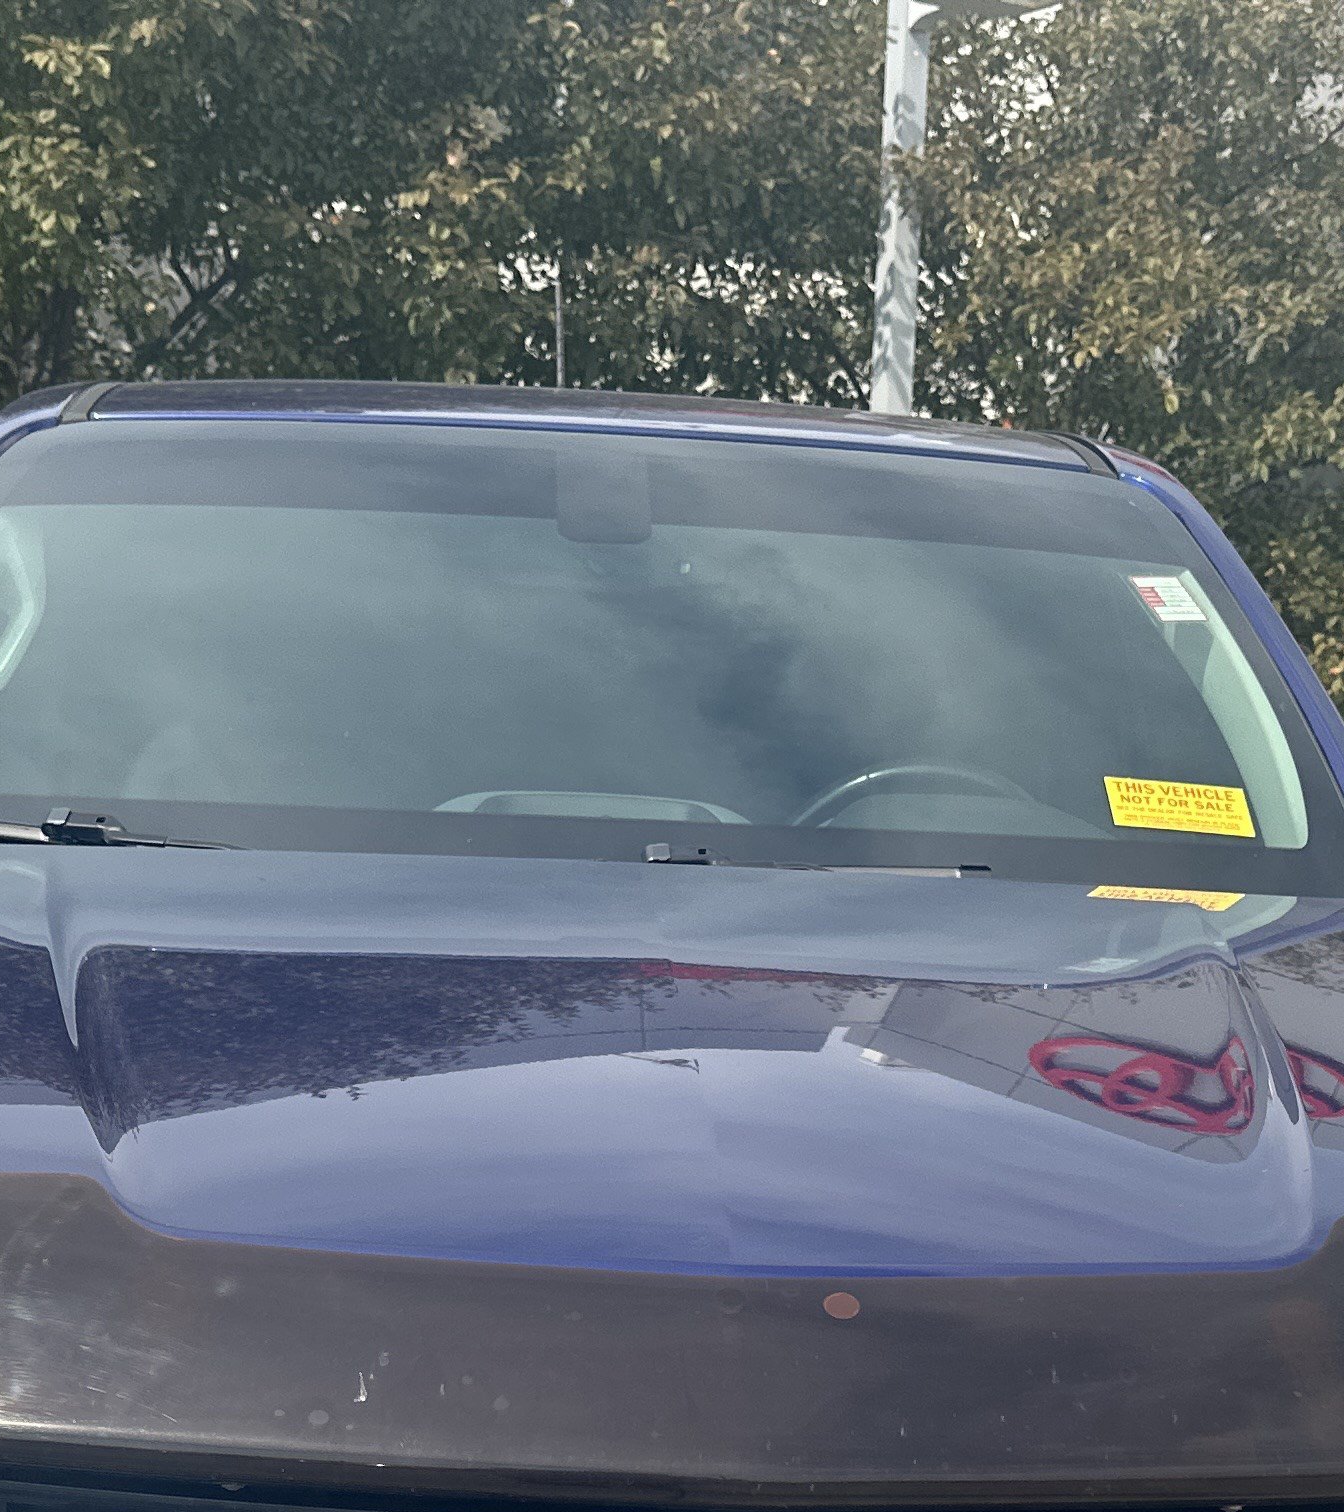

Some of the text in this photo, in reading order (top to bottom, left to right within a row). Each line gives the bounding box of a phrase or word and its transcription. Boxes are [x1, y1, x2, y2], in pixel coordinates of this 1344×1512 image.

[1113, 781, 1236, 802] THIS VEHICLE
[1120, 794, 1234, 812] NOT FOR SALE
